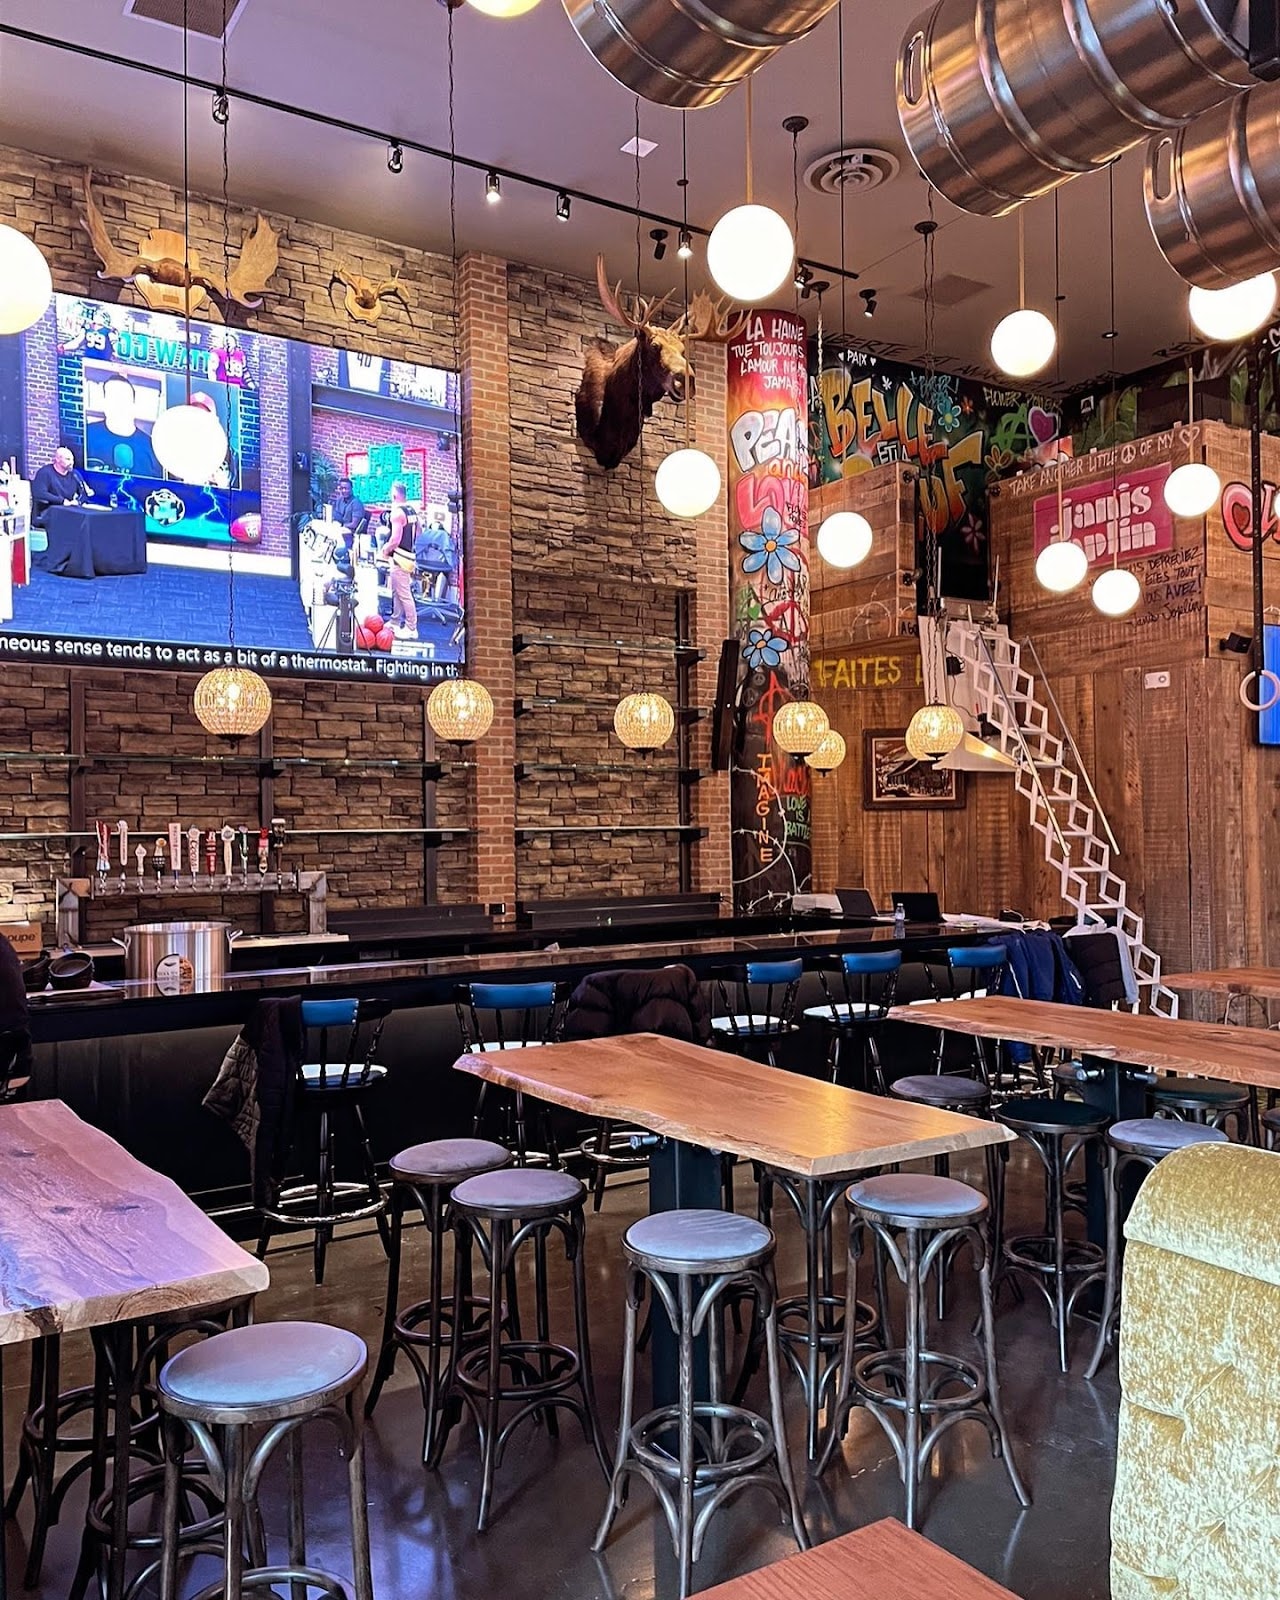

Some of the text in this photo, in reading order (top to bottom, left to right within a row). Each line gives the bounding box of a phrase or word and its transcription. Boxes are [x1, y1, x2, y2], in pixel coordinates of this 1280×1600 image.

[86, 333, 106, 350] 99
[746, 317, 805, 342] LA HAINE
[156, 338, 212, 374] WATT
[731, 341, 804, 358] TUE TOUJOURS
[847, 349, 868, 366] PAIX
[983, 387, 1022, 408] FLOWER
[820, 367, 950, 466] BELLE
[1009, 432, 1174, 496] TAKE ANOTHER LITTLE OF MY
[1061, 483, 1152, 543] janis
[1050, 518, 1156, 562] jplin
[1177, 565, 1199, 580] TOUT
[1166, 573, 1202, 600] AVEZ!
[0, 637, 51, 652] neous
[54, 639, 103, 656] sense
[106, 641, 151, 658] tends
[156, 645, 172, 660] to
[177, 648, 200, 662] act
[203, 650, 220, 663] as
[224, 651, 232, 663] a
[237, 649, 257, 665] bit
[261, 651, 276, 666] of
[279, 654, 287, 666] a
[376, 659, 427, 678] Fighting
[431, 663, 444, 677] in
[391, 640, 435, 658] ESPN
[814, 655, 902, 689] FAITES
[756, 754, 773, 862] IMAGINE
[786, 795, 807, 811] LOVE
[796, 810, 805, 822] IS
[8, 934, 36, 943] oupe
